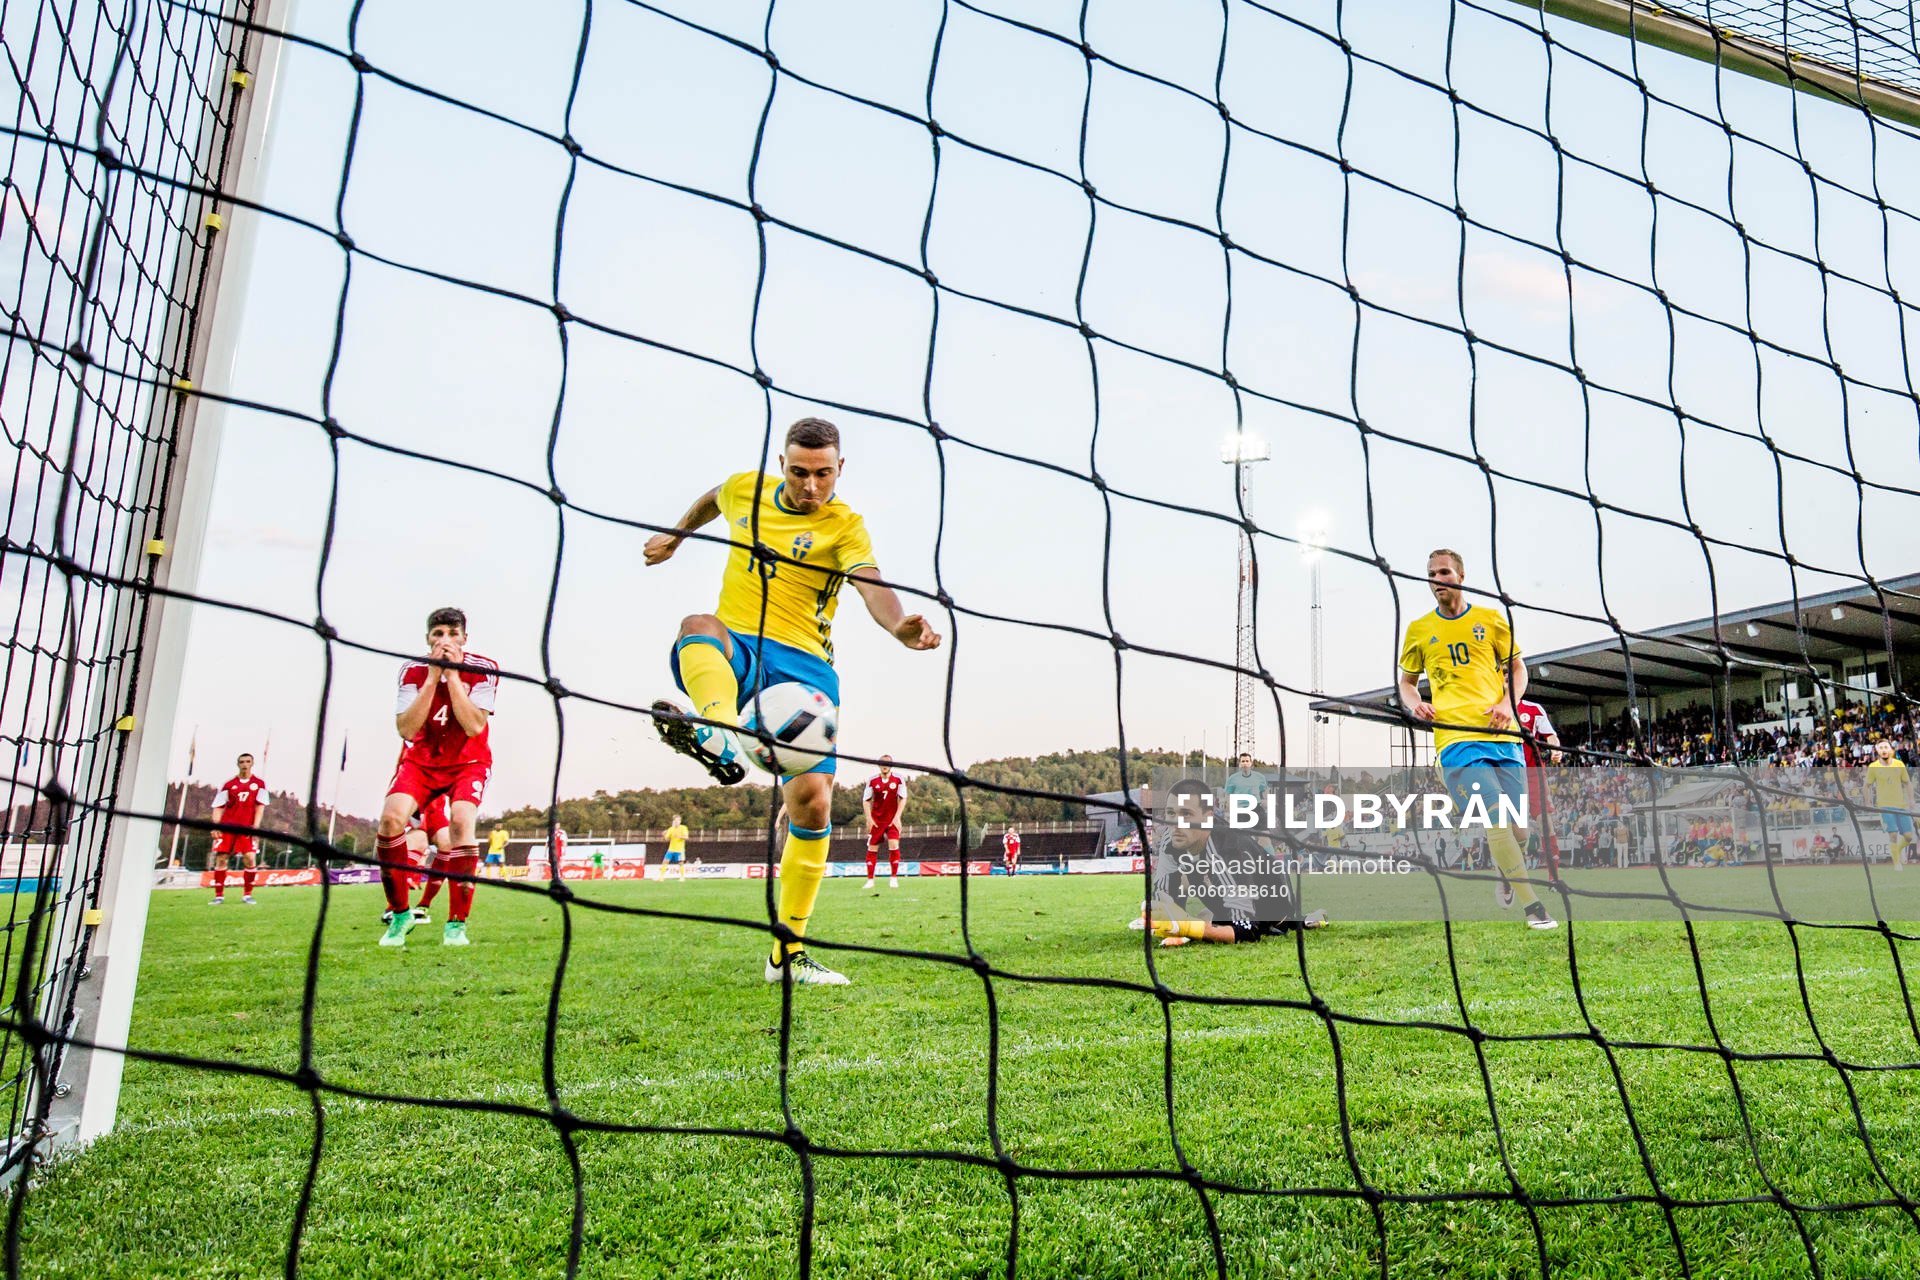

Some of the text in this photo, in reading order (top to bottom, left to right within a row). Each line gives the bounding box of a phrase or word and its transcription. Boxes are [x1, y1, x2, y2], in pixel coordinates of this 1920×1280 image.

[1447, 642, 1470, 667] 10
[433, 704, 448, 726] 4
[237, 791, 249, 802] 17
[882, 790, 888, 800] 7
[941, 863, 982, 874] Scadic
